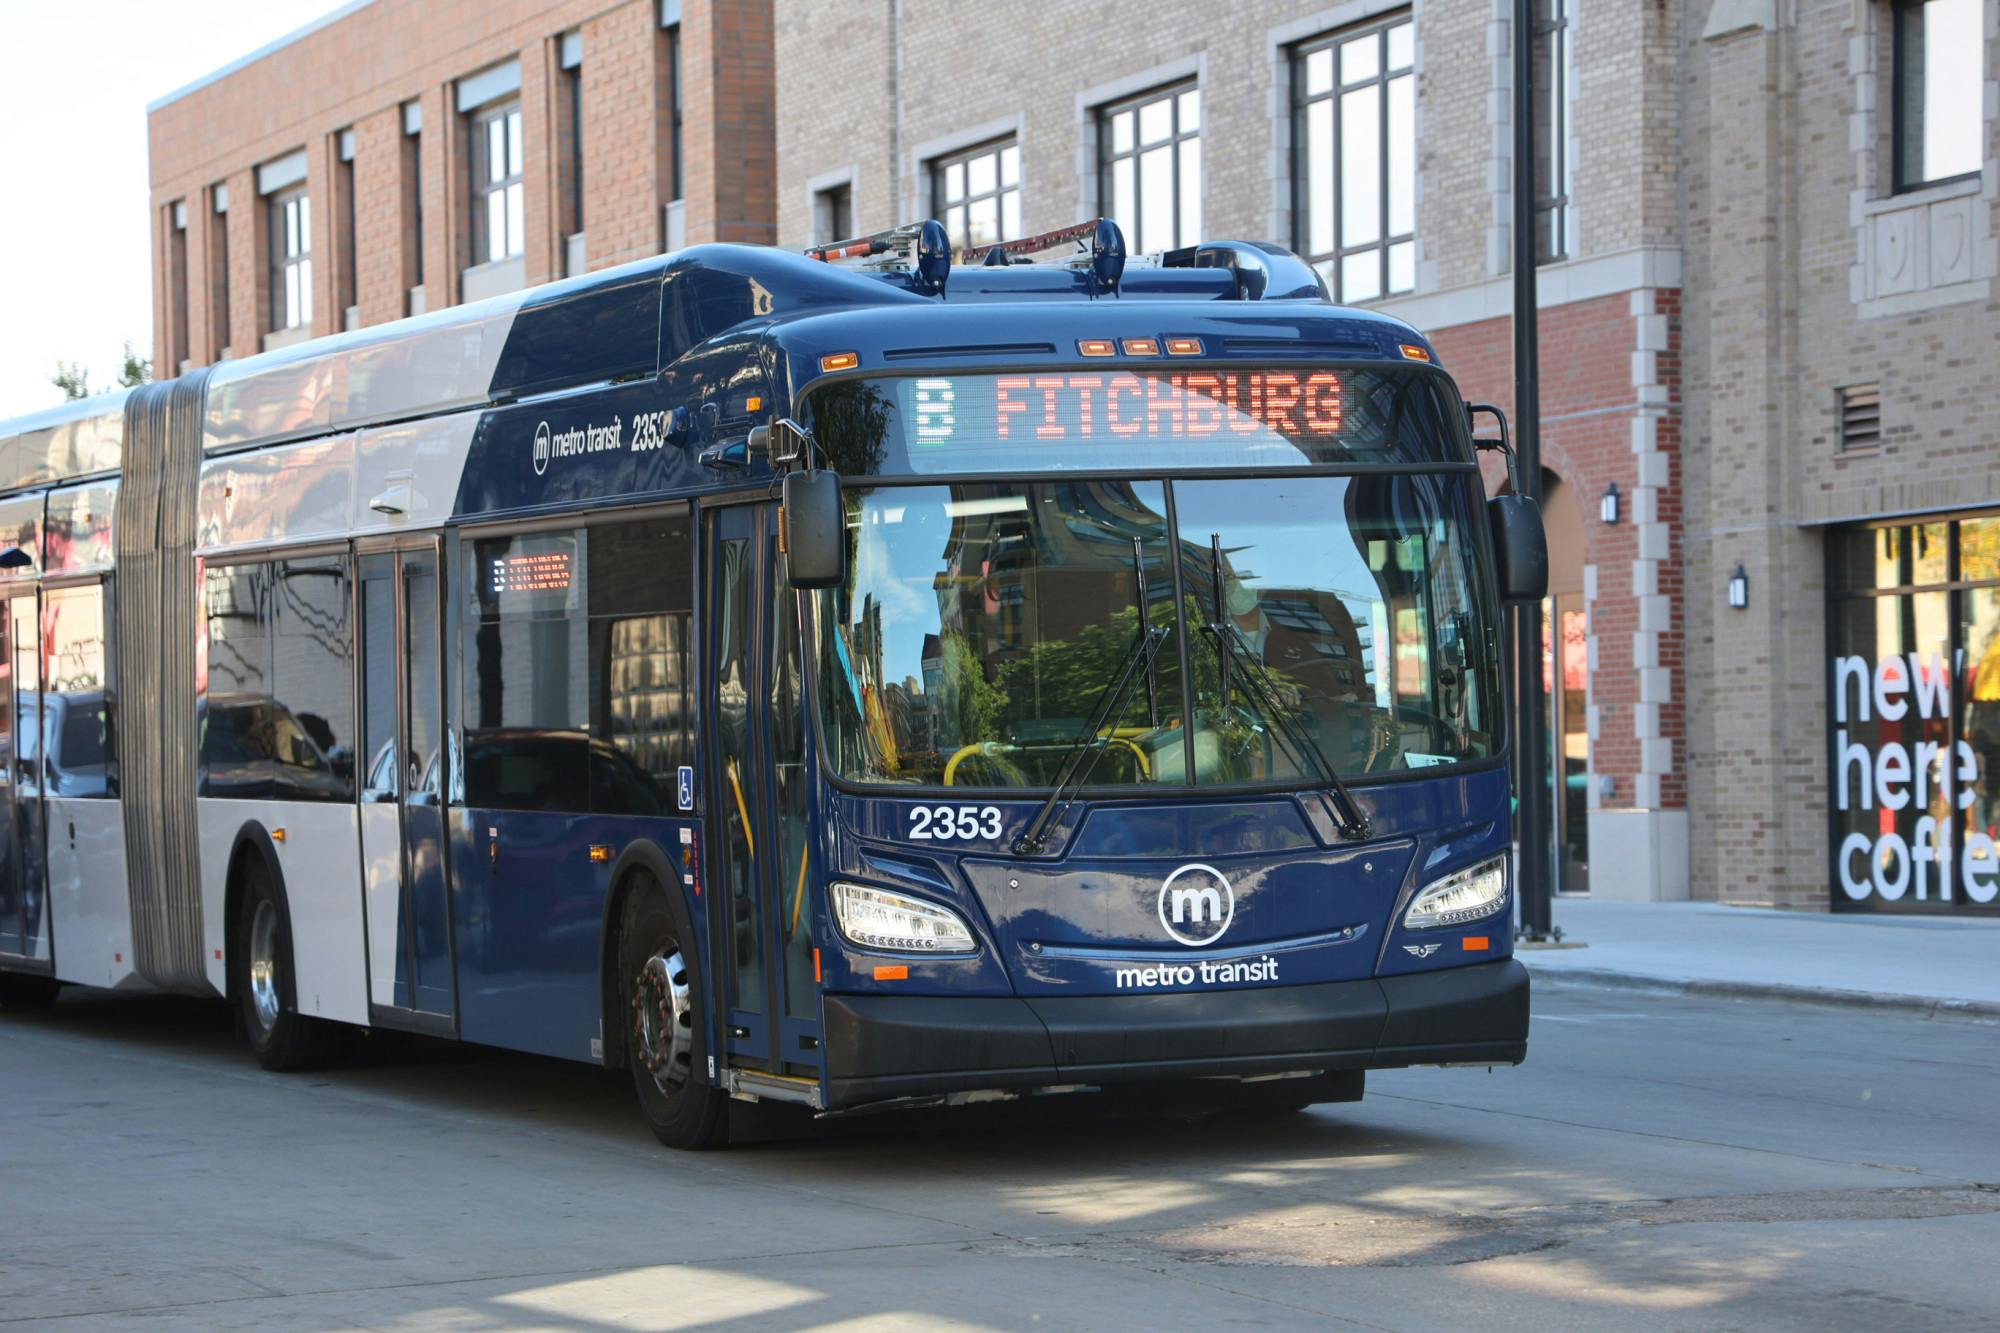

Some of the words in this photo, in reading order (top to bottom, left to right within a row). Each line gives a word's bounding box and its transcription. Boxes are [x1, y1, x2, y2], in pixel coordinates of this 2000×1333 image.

[551, 426, 586, 459] metro
[586, 415, 622, 453] transit
[915, 378, 955, 446] B
[997, 374, 1341, 439] FITCHBURG
[1835, 648, 1964, 723] new
[1836, 729, 1978, 811] here
[908, 805, 1003, 840] 2353
[1116, 963, 1195, 989] metro
[1199, 954, 1279, 984] transit
